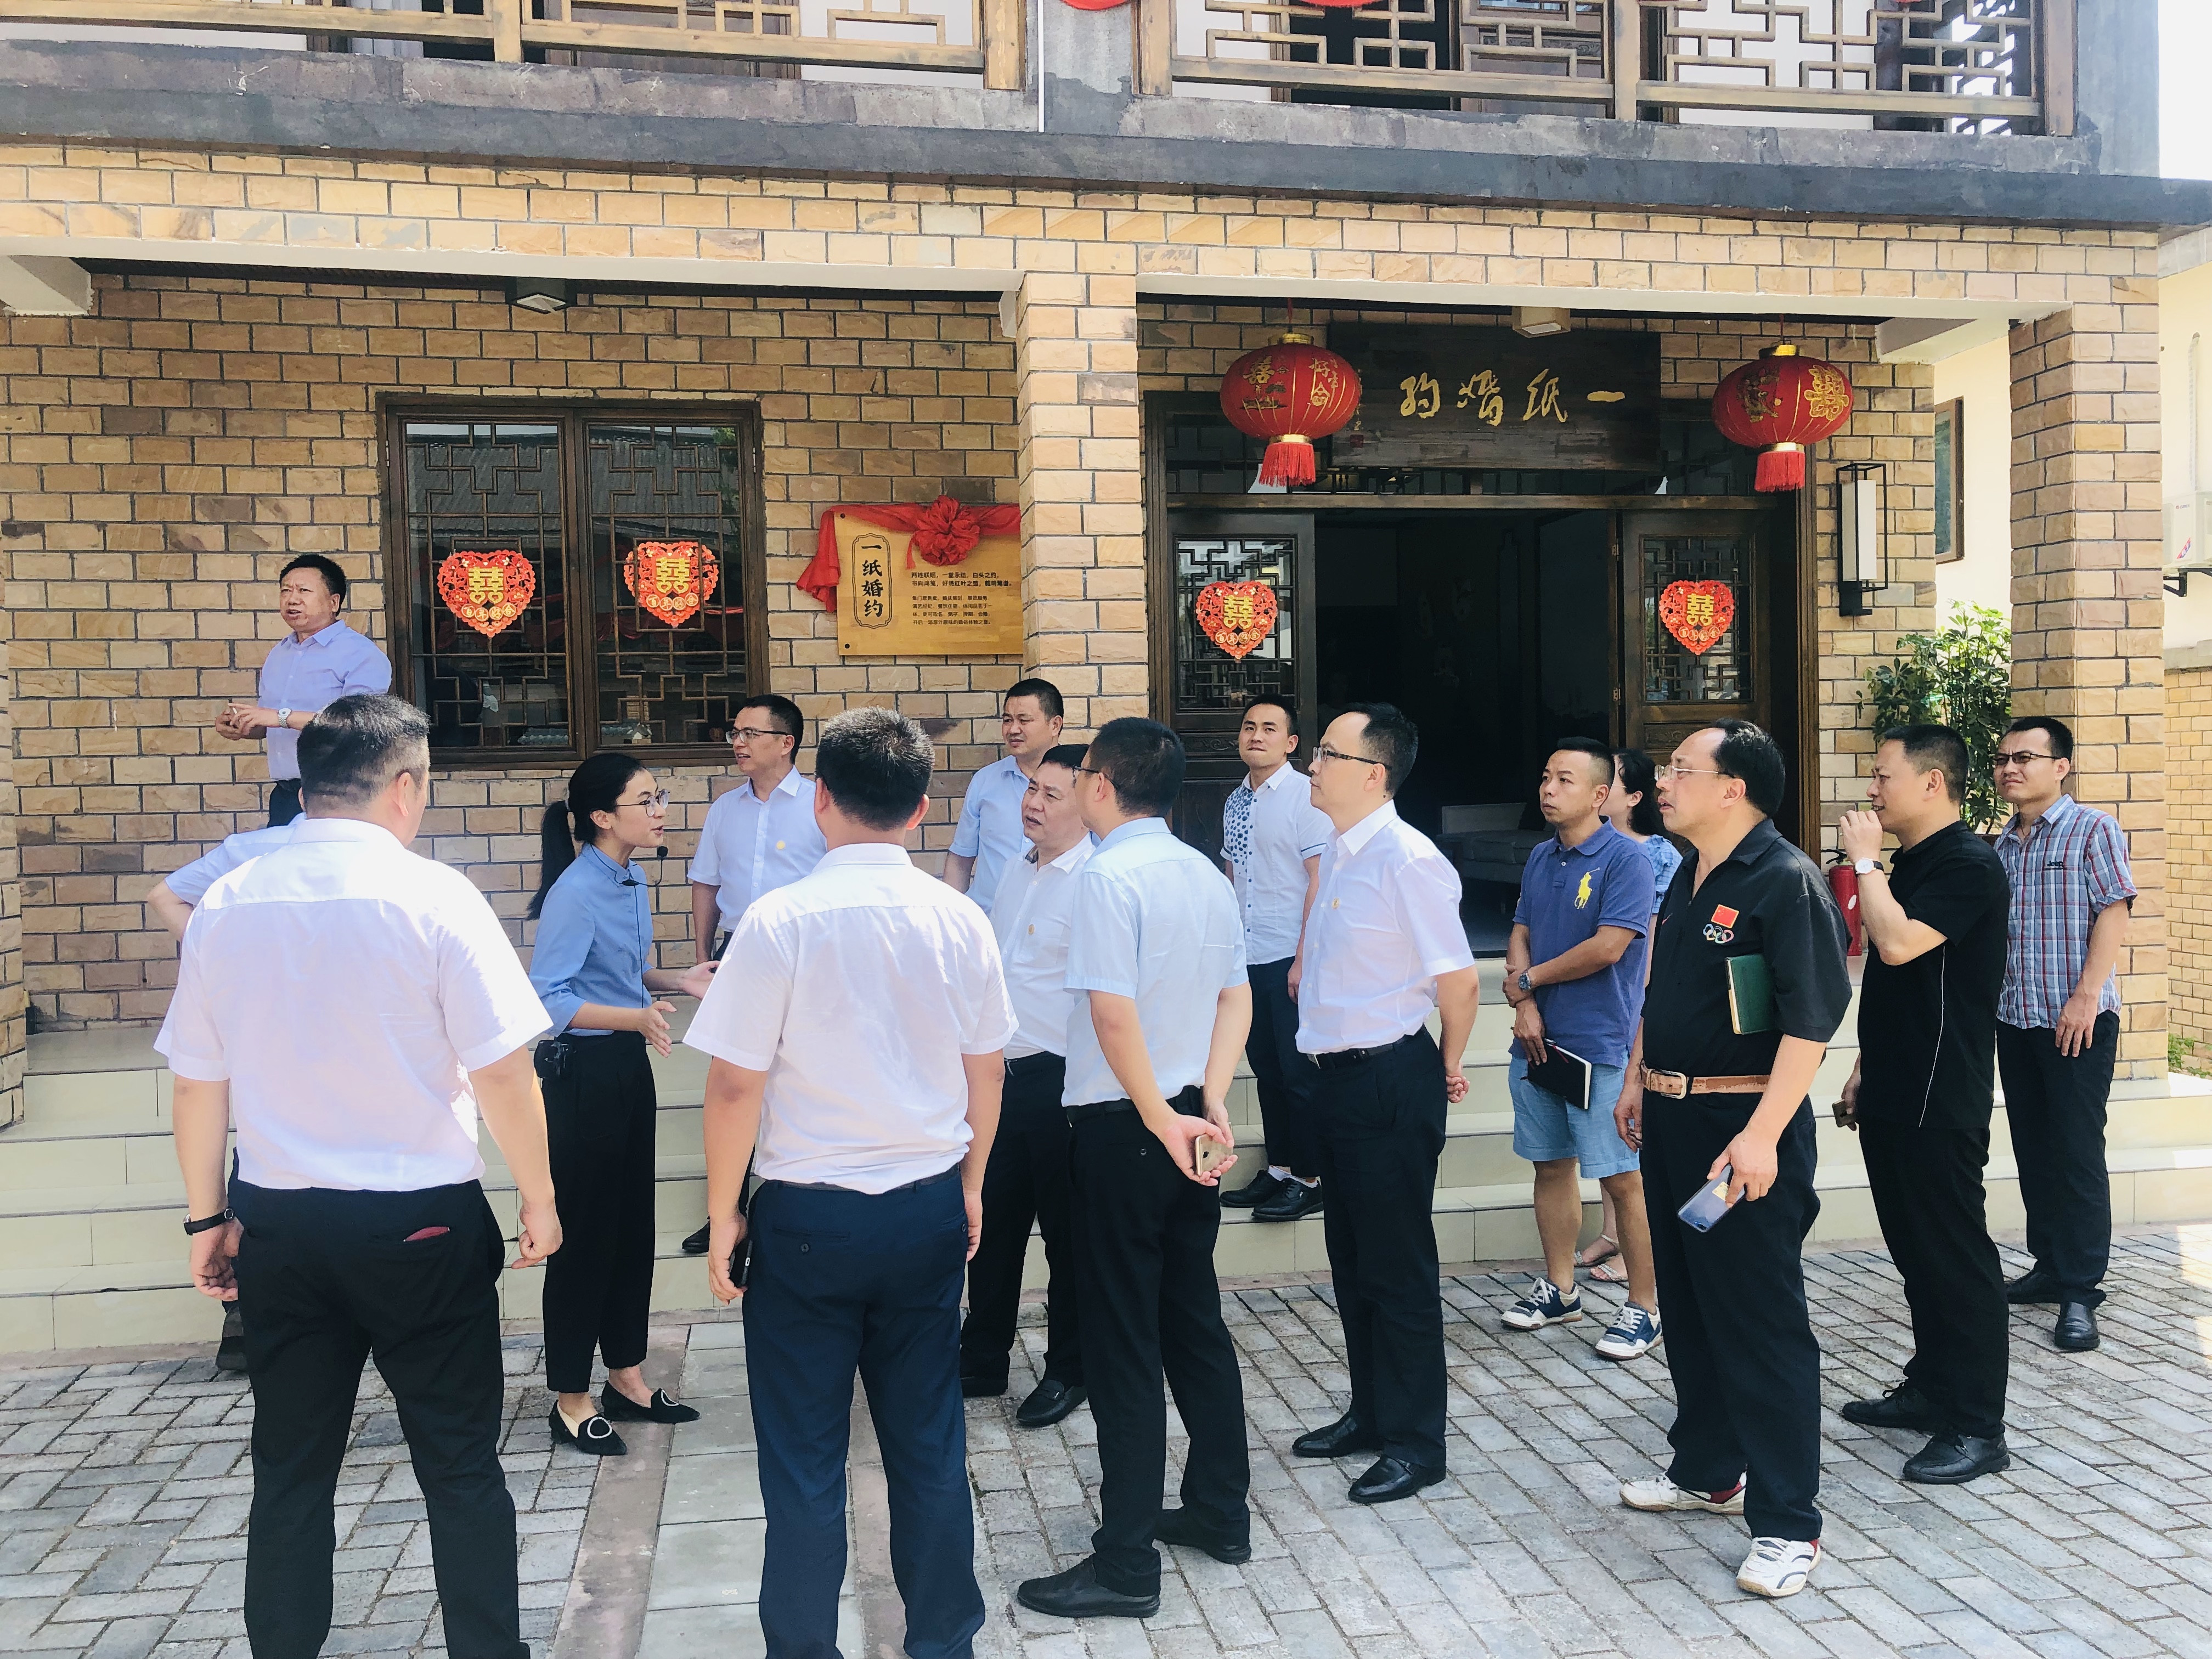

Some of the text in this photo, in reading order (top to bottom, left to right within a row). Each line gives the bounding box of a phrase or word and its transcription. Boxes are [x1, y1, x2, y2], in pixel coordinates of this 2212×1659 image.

[861, 544, 884, 618] 一纸婚约
[646, 593, 698, 611] 百年好合
[461, 602, 516, 621] 百年好合
[1215, 628, 1261, 645] 百年好合
[1678, 626, 1720, 641] 百年好合
[2047, 860, 2064, 868] Jeep
